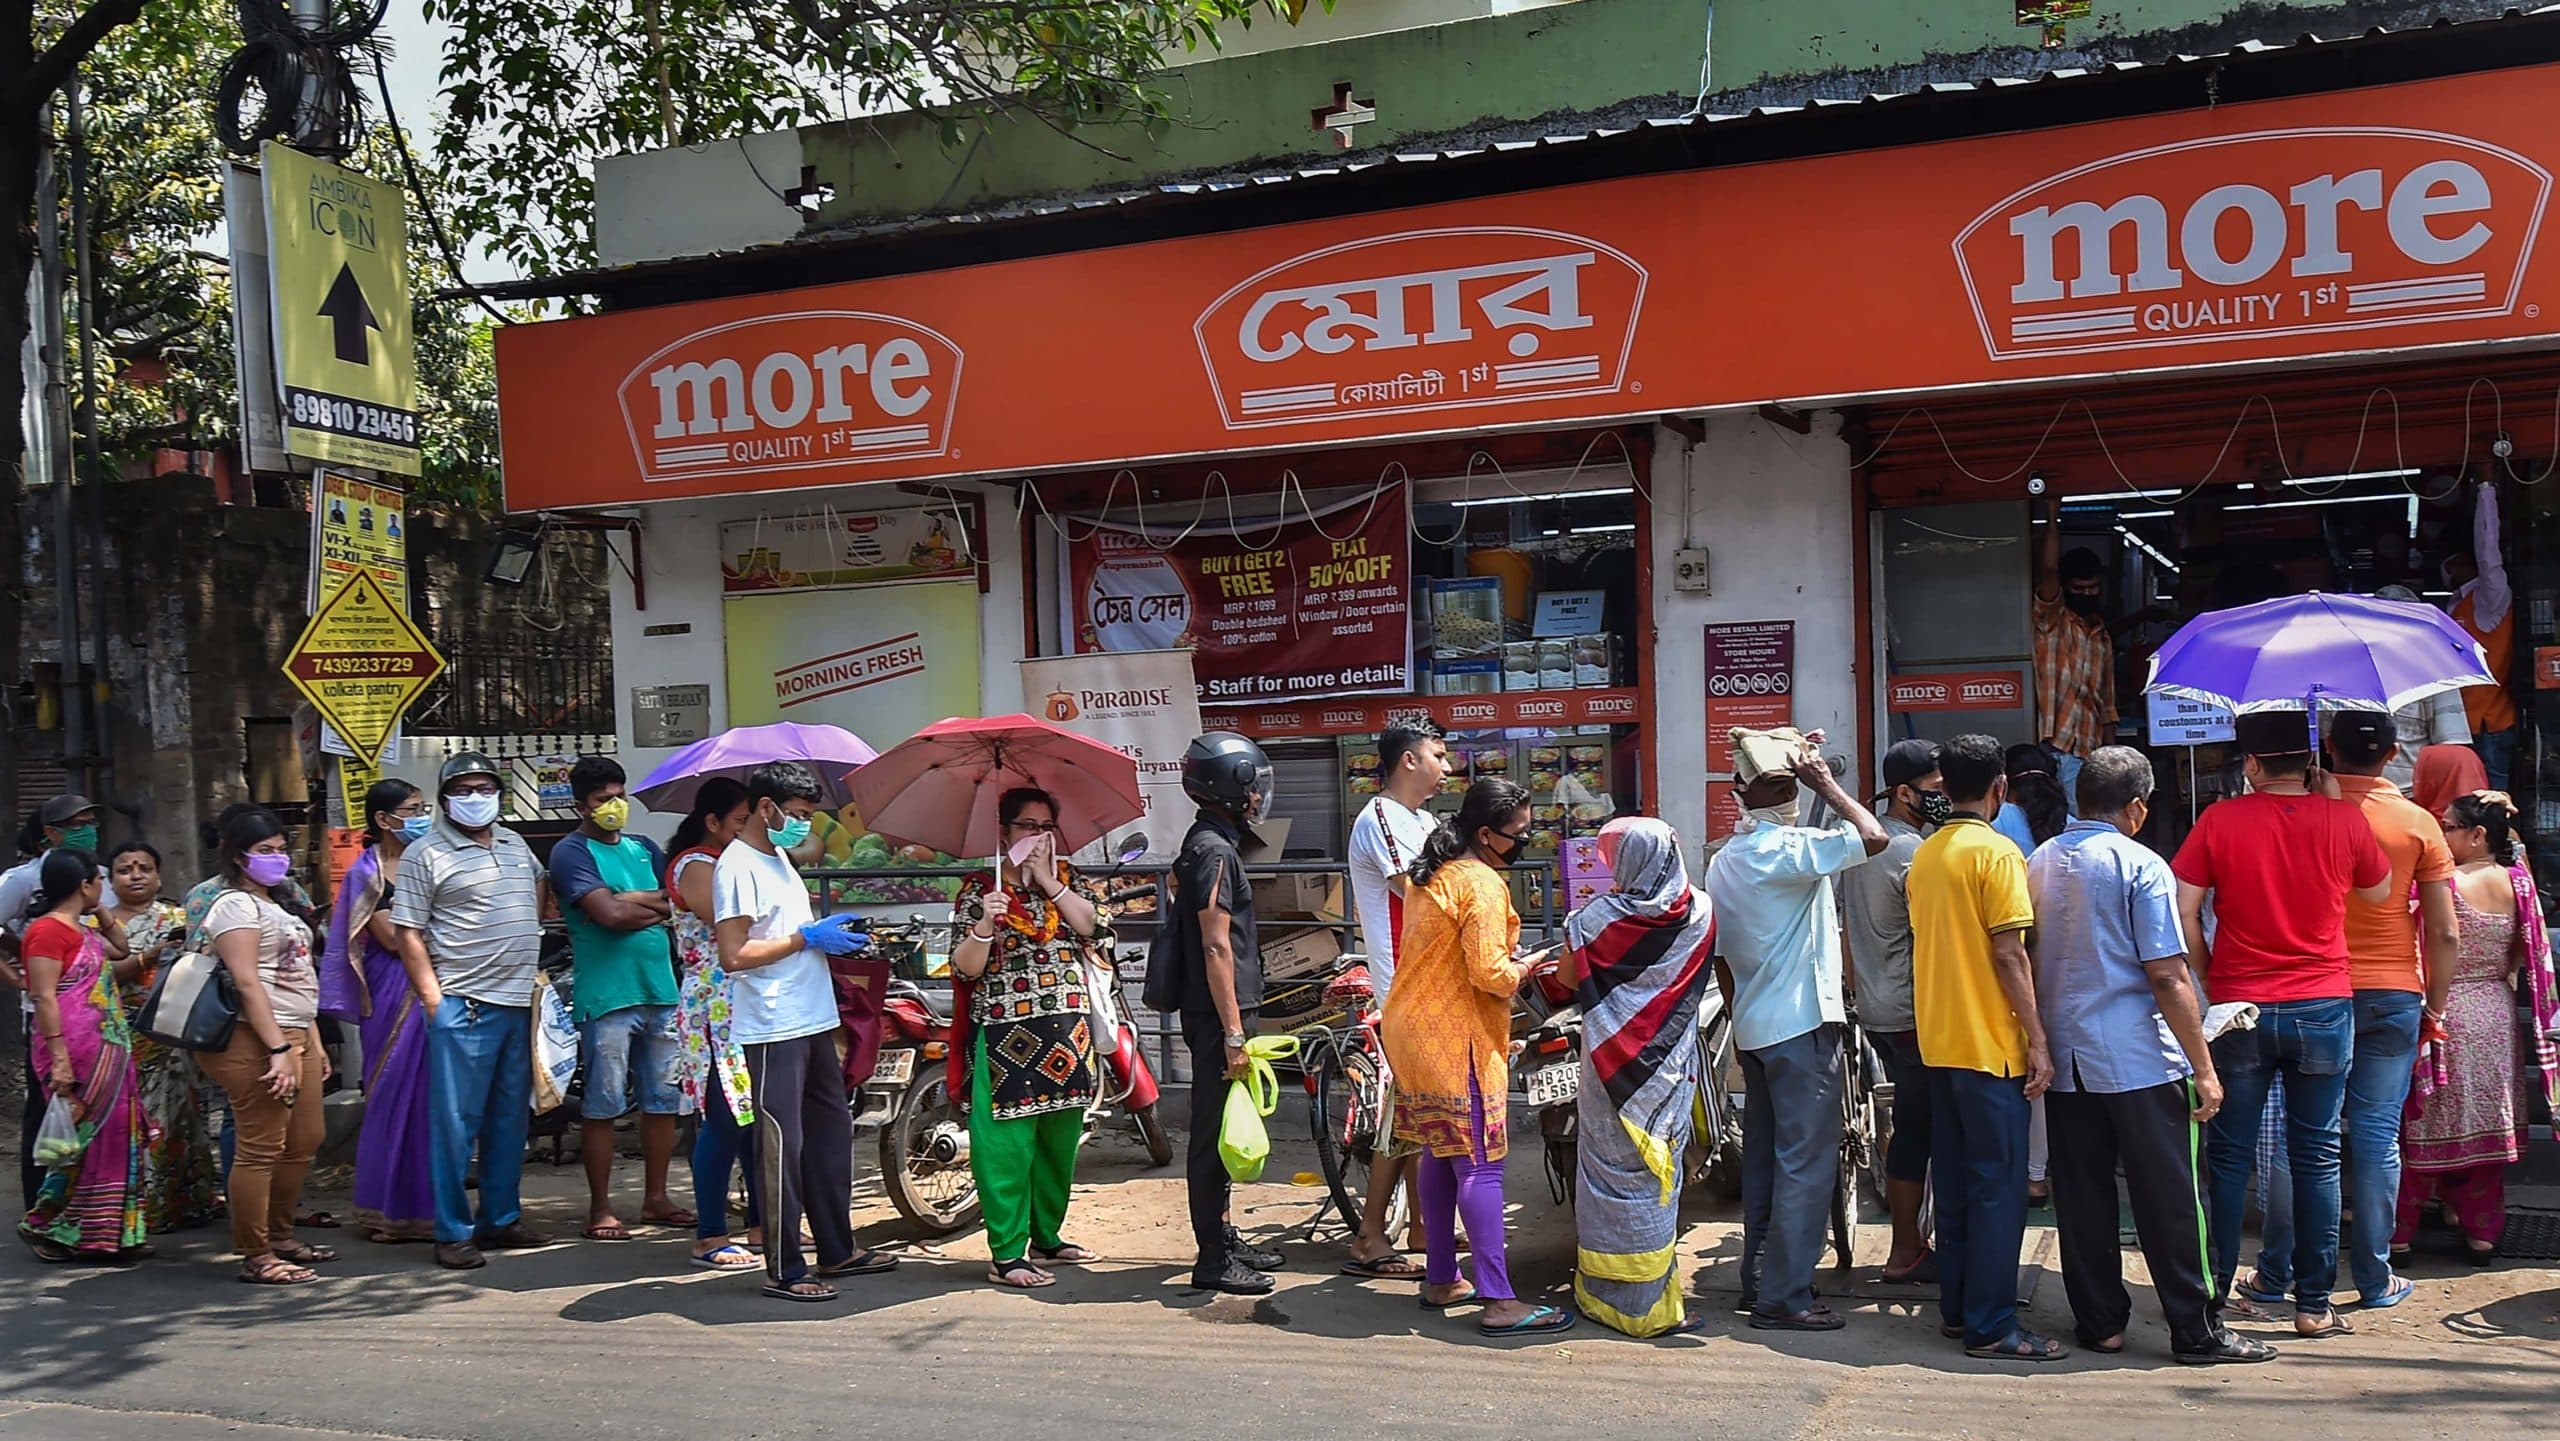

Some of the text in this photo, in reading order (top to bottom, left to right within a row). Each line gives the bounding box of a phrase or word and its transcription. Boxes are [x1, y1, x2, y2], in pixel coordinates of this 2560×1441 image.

[310, 173, 373, 213] AMBIKA
[2010, 160, 2493, 305] more
[1238, 251, 1596, 363] মোর
[2143, 281, 2339, 333] QUALITY 1st
[1458, 361, 1489, 394] 1st
[649, 337, 933, 440] more
[293, 393, 354, 431] 89810
[356, 404, 415, 443] 23456
[732, 427, 846, 463] QUALITY 1st
[1332, 537, 1367, 560] FLAT
[1201, 550, 1286, 574] BUY 1 GET 2
[1219, 571, 1275, 598] FREE
[1303, 592, 1328, 606] MRP
[1356, 584, 1398, 600] onwards
[1138, 594, 1186, 624] সেল
[1223, 602, 1246, 614] MRP
[1298, 610, 1338, 623] Window
[1345, 605, 1369, 618] Door
[1370, 601, 1406, 615] curtain
[1211, 614, 1287, 631] Double bedsheet
[1332, 620, 1374, 636] assorted
[312, 657, 414, 674] 7439233729
[775, 645, 925, 698] MORNING FRESH
[1209, 676, 1253, 696] Staff
[1257, 675, 1284, 692] for
[1288, 673, 1336, 691] more
[1341, 664, 1405, 687] details
[322, 681, 405, 700] kolkata pantry
[1896, 685, 1946, 699] more
[1963, 683, 2014, 697] more
[1387, 706, 1429, 720] more
[1452, 703, 1496, 717] more
[1519, 700, 1563, 714] more
[1588, 697, 1633, 711] more
[2177, 703, 2198, 713] than
[1201, 714, 1239, 727] more
[1261, 712, 1301, 725] more
[1323, 710, 1364, 723] more
[2158, 715, 2213, 728] coustomars
[2215, 715, 2225, 725] at
[2185, 729, 2207, 739] time
[1281, 1008, 1335, 1034] Namkeens
[1537, 1088, 1546, 1102] C
